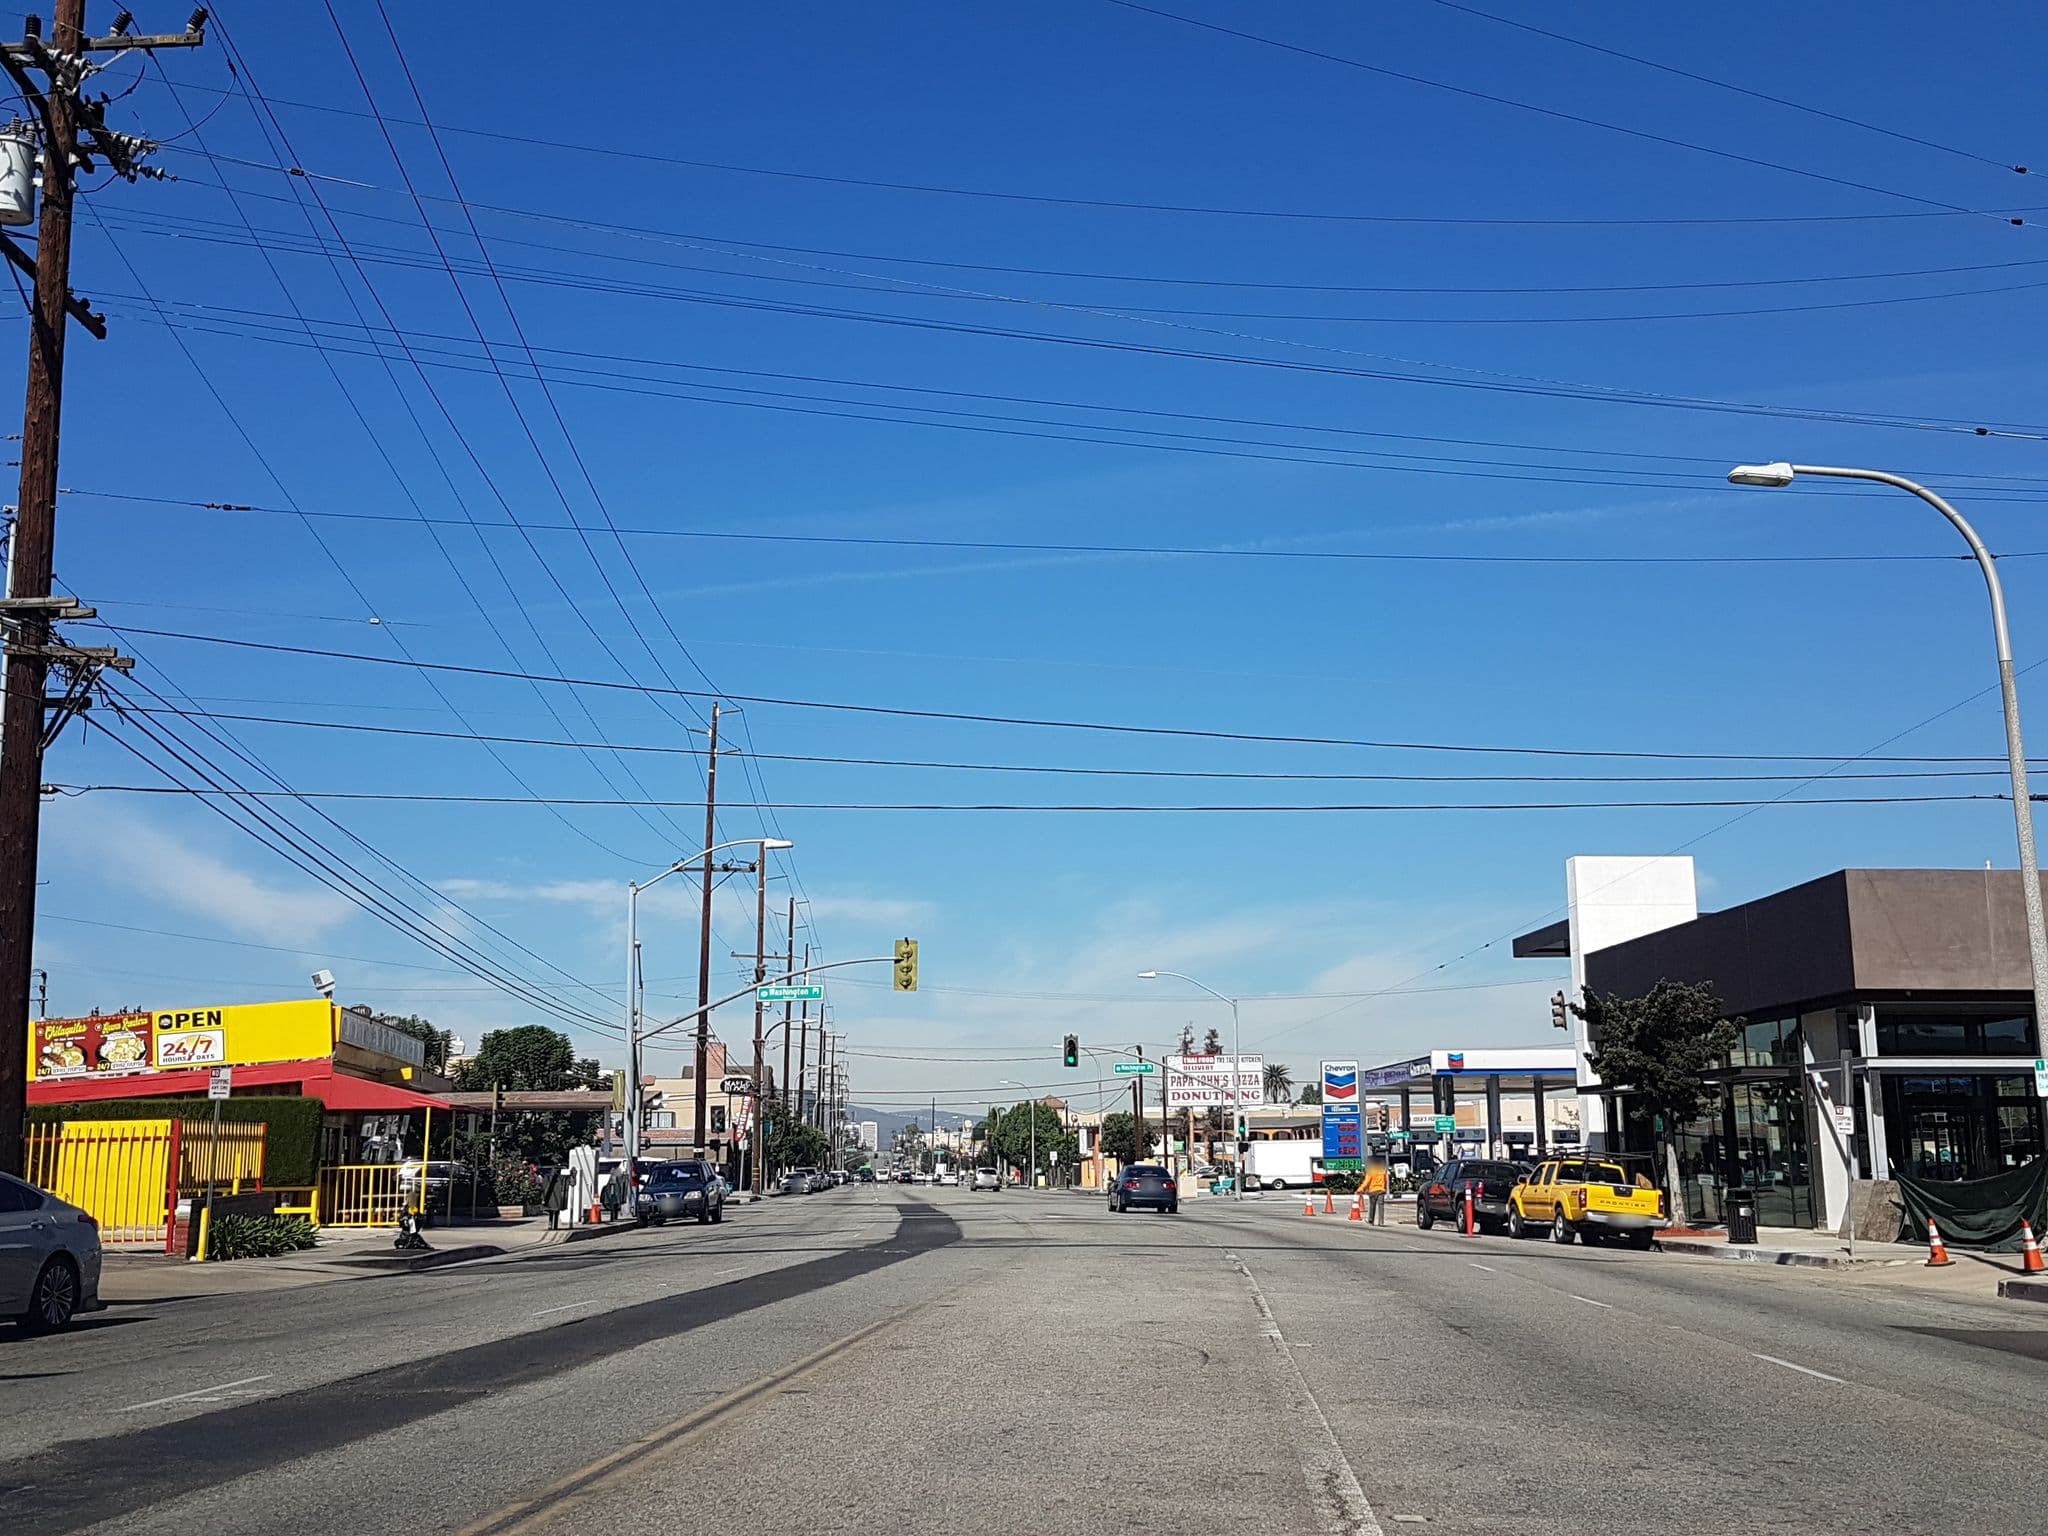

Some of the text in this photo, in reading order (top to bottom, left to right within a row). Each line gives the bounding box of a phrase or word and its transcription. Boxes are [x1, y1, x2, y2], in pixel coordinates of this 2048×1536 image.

[158, 1010, 222, 1029] OPEN
[45, 1022, 88, 1040] Chilaquiles
[196, 1053, 215, 1061] DAYS
[1170, 1075, 1194, 1087] PAPA
[1171, 1091, 1220, 1101] DONUT
[1600, 1199, 1646, 1208] FRONTIER
